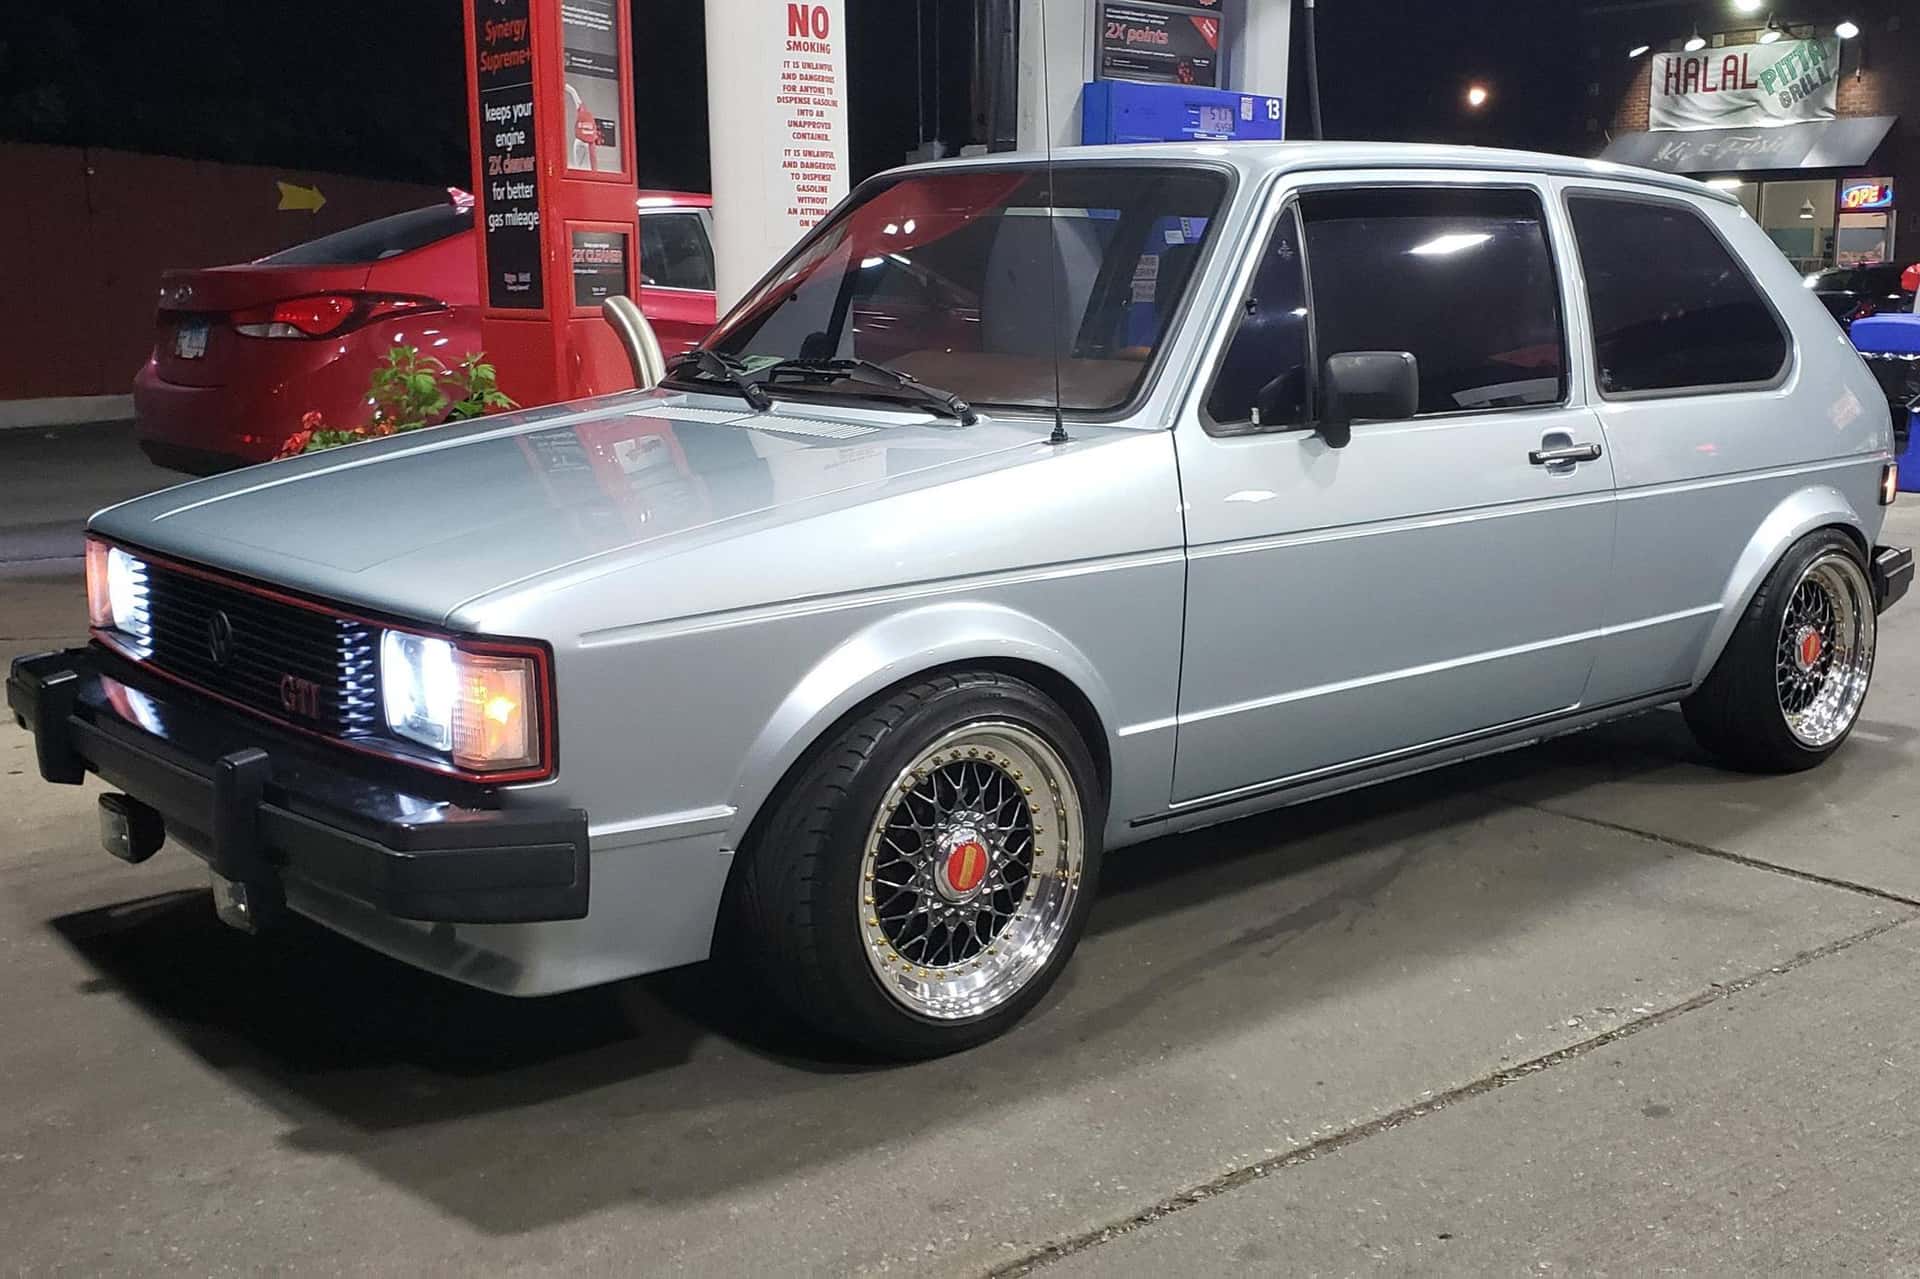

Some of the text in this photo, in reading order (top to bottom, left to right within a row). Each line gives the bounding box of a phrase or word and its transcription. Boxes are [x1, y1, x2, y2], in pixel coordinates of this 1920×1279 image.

[787, 3, 829, 39] NO
[485, 18, 527, 45] Synergy
[1105, 22, 1168, 45] 2X points
[786, 40, 831, 54] SMOKING
[784, 61, 790, 69] IT
[793, 61, 799, 69] IS
[1664, 53, 1758, 96] HALAL
[1759, 39, 1828, 96] PITTA
[781, 72, 797, 81] AND
[800, 85, 825, 95] ANYONE
[1778, 66, 1833, 109] GRILL
[777, 95, 811, 105] DISPENSE
[1266, 98, 1280, 120] 13
[485, 102, 532, 125] keeps your
[797, 109, 814, 117] INTO
[495, 127, 525, 151] engine
[784, 149, 834, 159] IT IS UNLAWFUL
[782, 161, 836, 170] AND DANGEROUS
[790, 173, 831, 182] TO DISPENSE
[492, 181, 534, 200] for better
[796, 184, 828, 194] GASOLINE
[797, 196, 828, 205] WITHOUT
[489, 207, 539, 232] gas mileage
[281, 673, 321, 719] GTI
